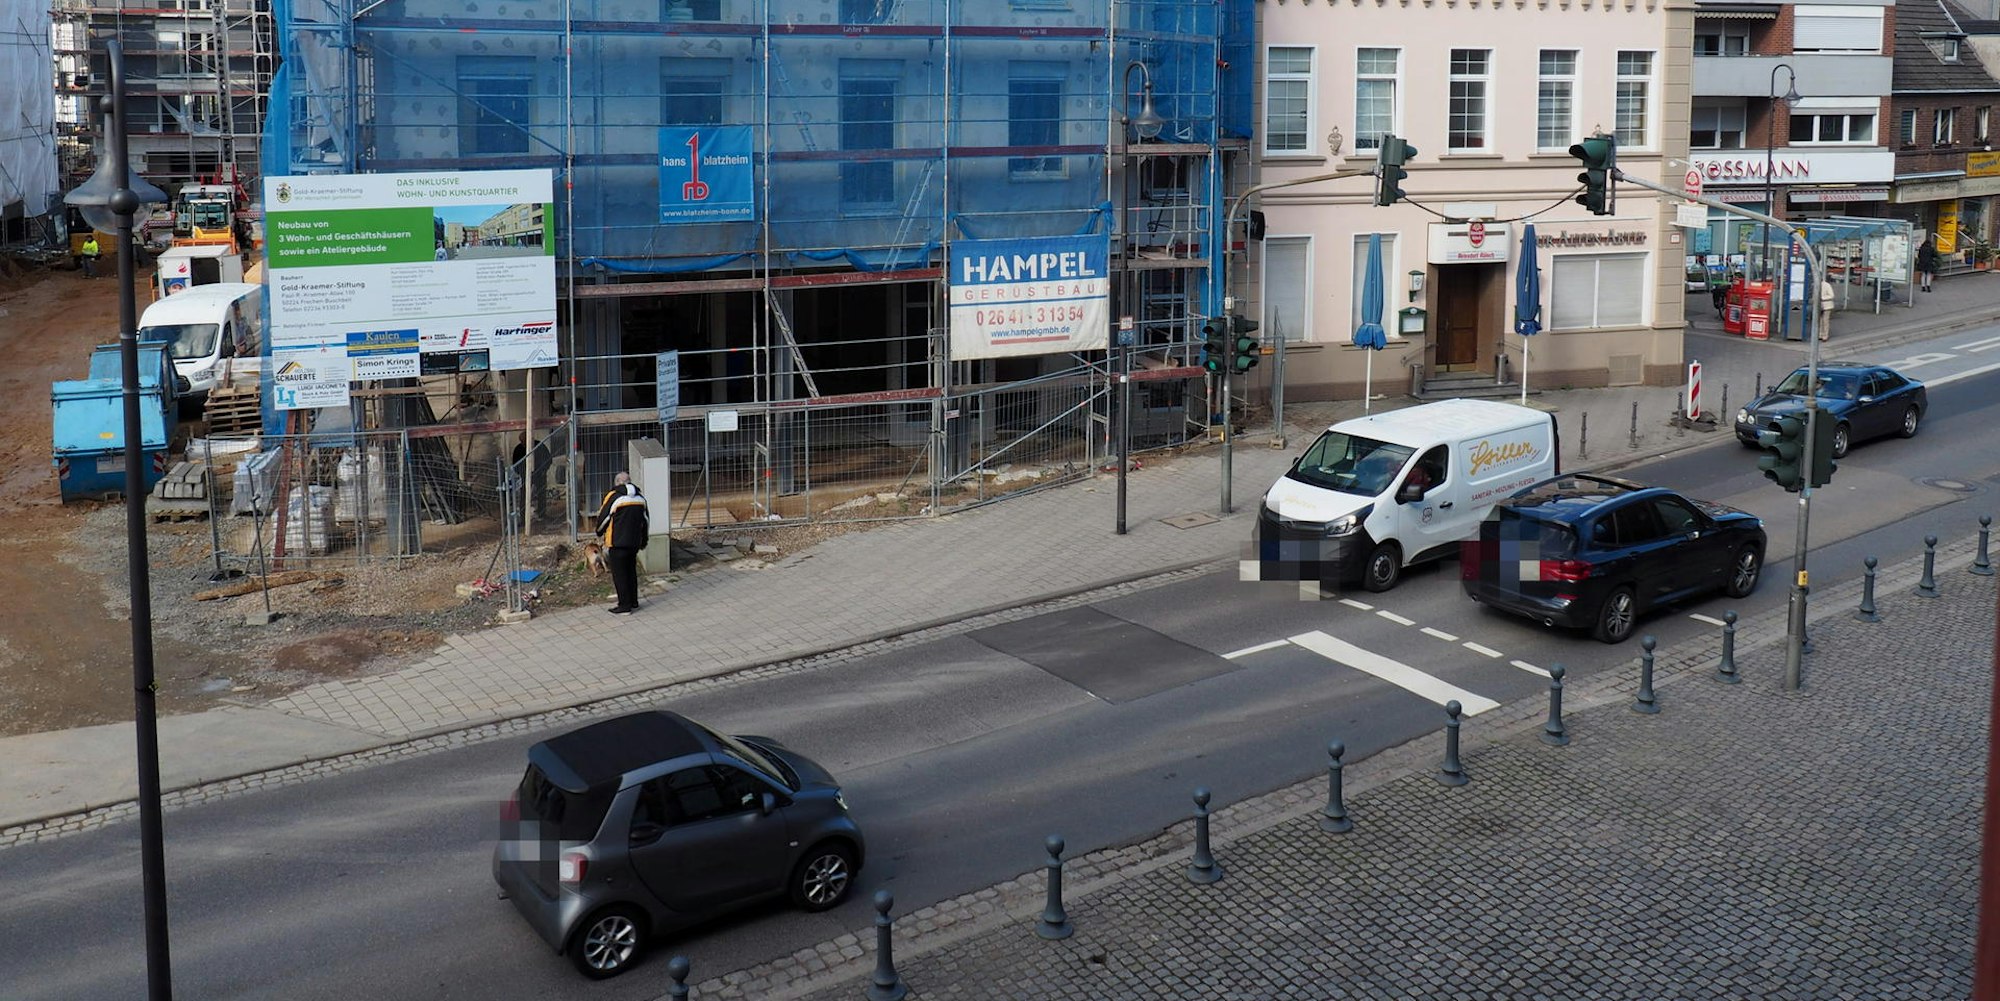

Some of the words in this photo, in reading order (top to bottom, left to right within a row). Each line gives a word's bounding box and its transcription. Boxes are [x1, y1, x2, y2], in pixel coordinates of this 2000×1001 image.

[662, 156, 686, 167] hans
[703, 155, 749, 166] blatzheim
[396, 179, 414, 187] DAS
[416, 177, 460, 186] INKLUSIVE
[397, 190, 427, 199] WOHN-
[429, 189, 447, 198] UND
[449, 187, 518, 197] KUNSTQUARTIER
[663, 208, 750, 218] www.blatzheim-bonn.de
[278, 221, 311, 230] Neubau
[313, 221, 329, 229] von
[279, 234, 285, 243] 3
[285, 233, 314, 242] Wohn-
[316, 233, 333, 241] und
[334, 231, 411, 241] Geschäftshäusern
[279, 246, 305, 256] sowie
[306, 246, 321, 255] ein
[322, 244, 387, 256] Ateliergebäude
[963, 251, 1096, 283] HAMPEL
[280, 281, 366, 292] Gold-Kraemer-Stiftung
[976, 310, 984, 326] 0
[366, 331, 400, 341] Kaulen
[991, 325, 1071, 338] www.hampelgmbh.de
[357, 360, 385, 368] Simon
[386, 358, 415, 367] Krings
[276, 373, 316, 382] SCHAUERTE
